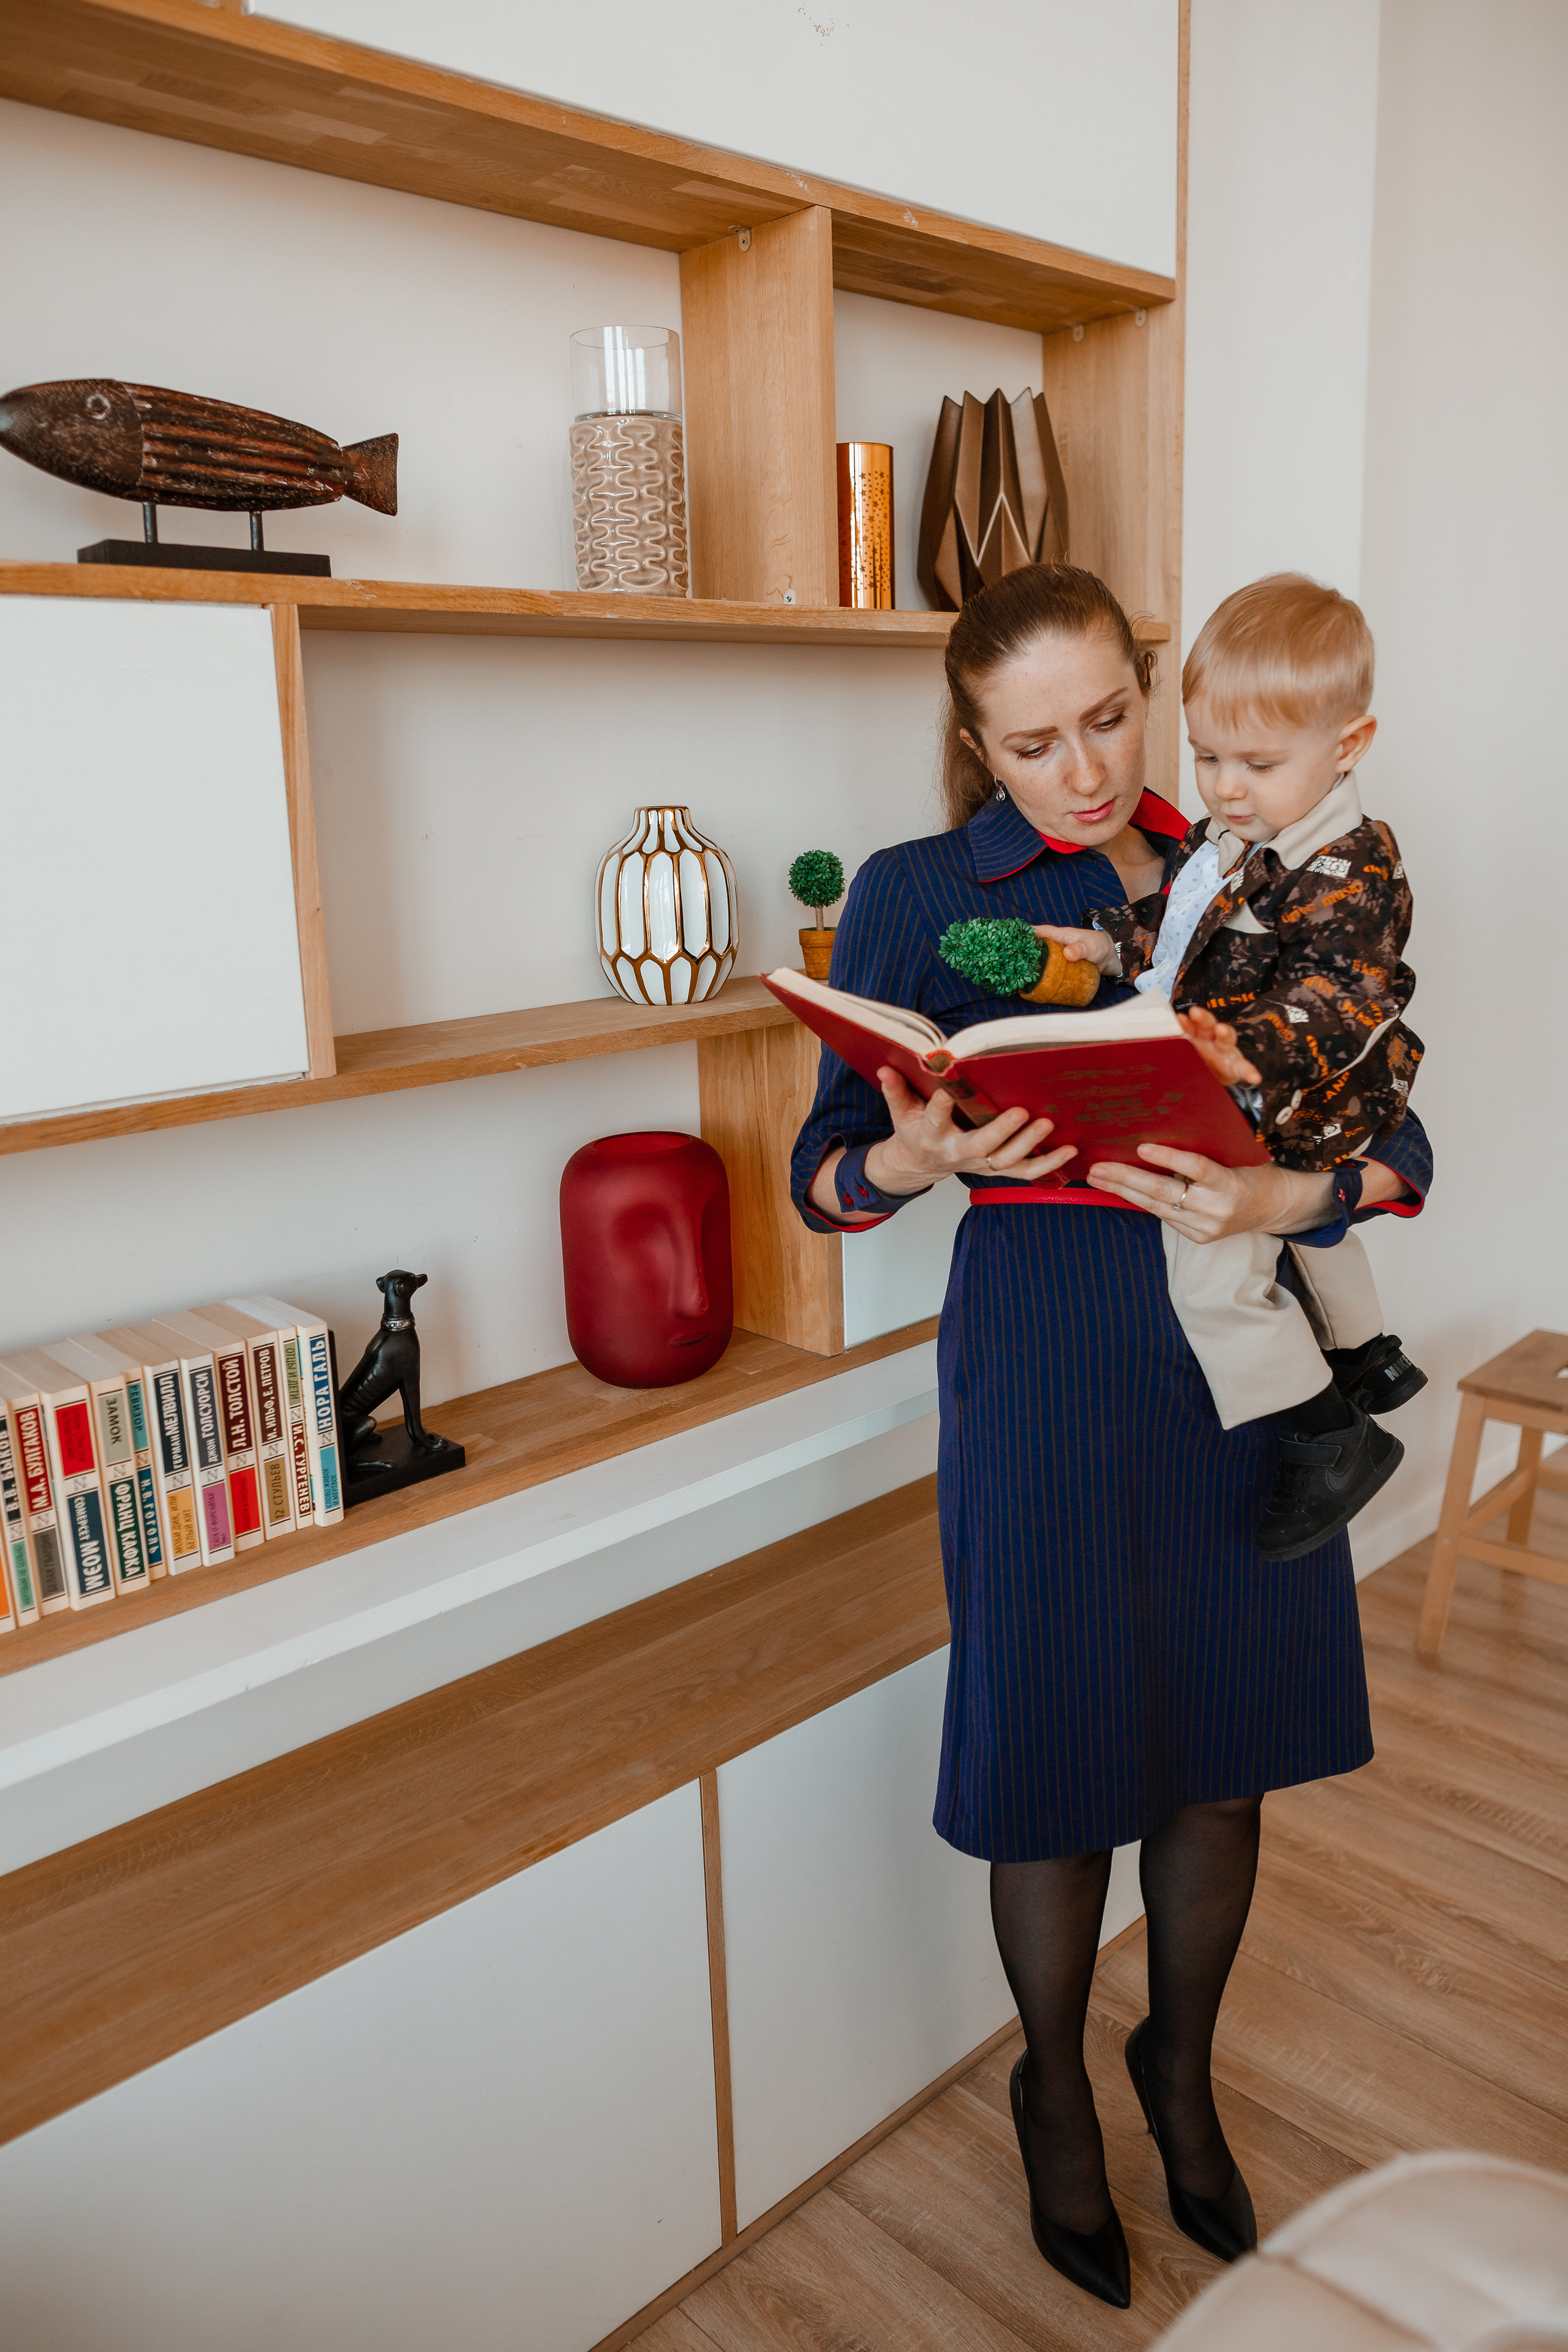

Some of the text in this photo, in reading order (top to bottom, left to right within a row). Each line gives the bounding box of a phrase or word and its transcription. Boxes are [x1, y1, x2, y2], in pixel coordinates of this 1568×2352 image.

[258, 1349, 272, 1387] ПЕТРОВ
[285, 1348, 296, 1370] ОТЦЫ
[311, 1340, 332, 1428] НОРА ГАЛЬ
[1384, 1355, 1412, 1381] NIKE
[129, 1385, 143, 1431] РЕВИЗОР
[222, 1358, 247, 1448] Л.Н. ТОЛСТОЙ
[288, 1379, 298, 1400] ДЕТИ
[106, 1397, 122, 1445] ЗАМОК
[159, 1375, 183, 1469] ГЕРМАН МЕЛВИЛЛ
[195, 1372, 219, 1463] ДЖОН ГОЛСУОРСИ
[20, 1411, 49, 1510] М.А. БУЛГАКОВ
[293, 1426, 310, 1512] И.С. ТУРГЕНЕВ
[4, 1482, 19, 1512] В.В.
[169, 1495, 179, 1511] ИЛИ
[270, 1463, 284, 1519] 12 СТУЛЬЕВ
[74, 1496, 105, 1591] СОМЕРСЕТ МОЭМ
[115, 1483, 141, 1577] ФРАНЦ КАФКА
[144, 1502, 159, 1554] ГОГОЛЬ
[173, 1531, 183, 1554] МОБИ
[182, 1509, 195, 1550] БЕЛЫЙ КИТ
